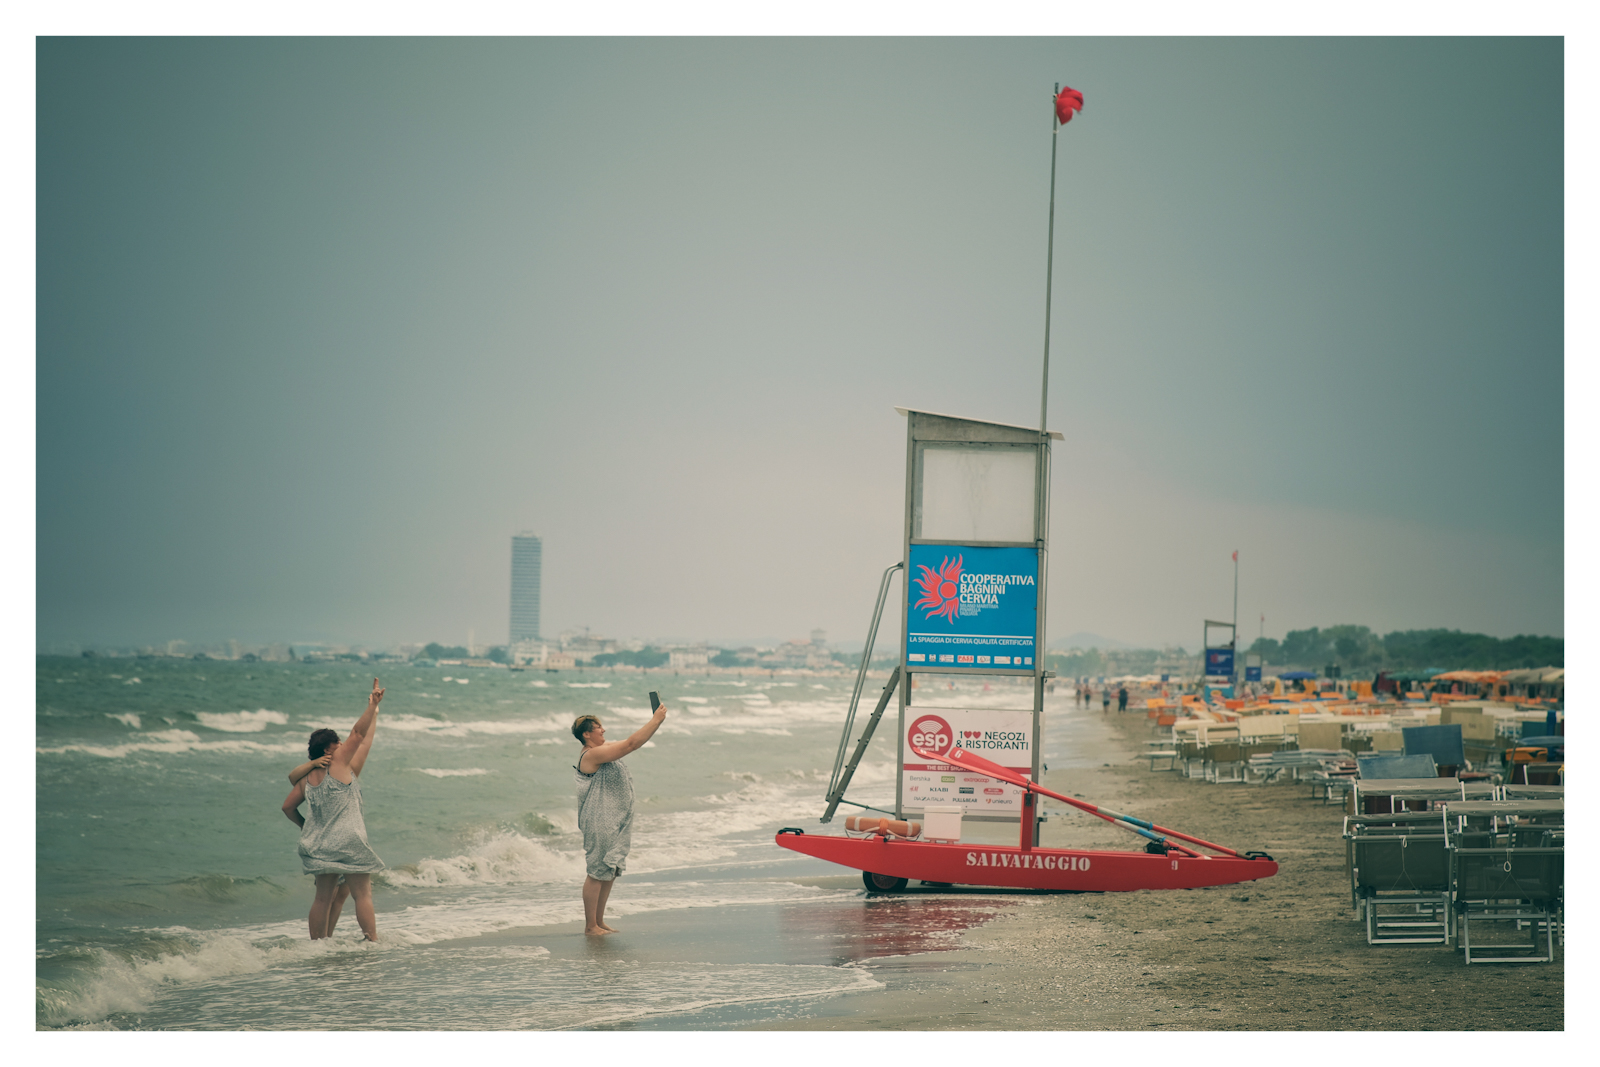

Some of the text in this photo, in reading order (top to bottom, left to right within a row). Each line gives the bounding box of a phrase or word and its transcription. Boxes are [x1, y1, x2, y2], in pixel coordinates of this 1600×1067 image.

[960, 573, 1035, 585] COOPERATIVA
[960, 583, 1006, 594] BAGNINI
[960, 593, 999, 604] CERVIA
[984, 731, 1026, 741] NEGOZI
[912, 733, 948, 751] esp
[955, 740, 1029, 750] & RISTORANTI
[966, 852, 1091, 871] SALVATAGGIO
